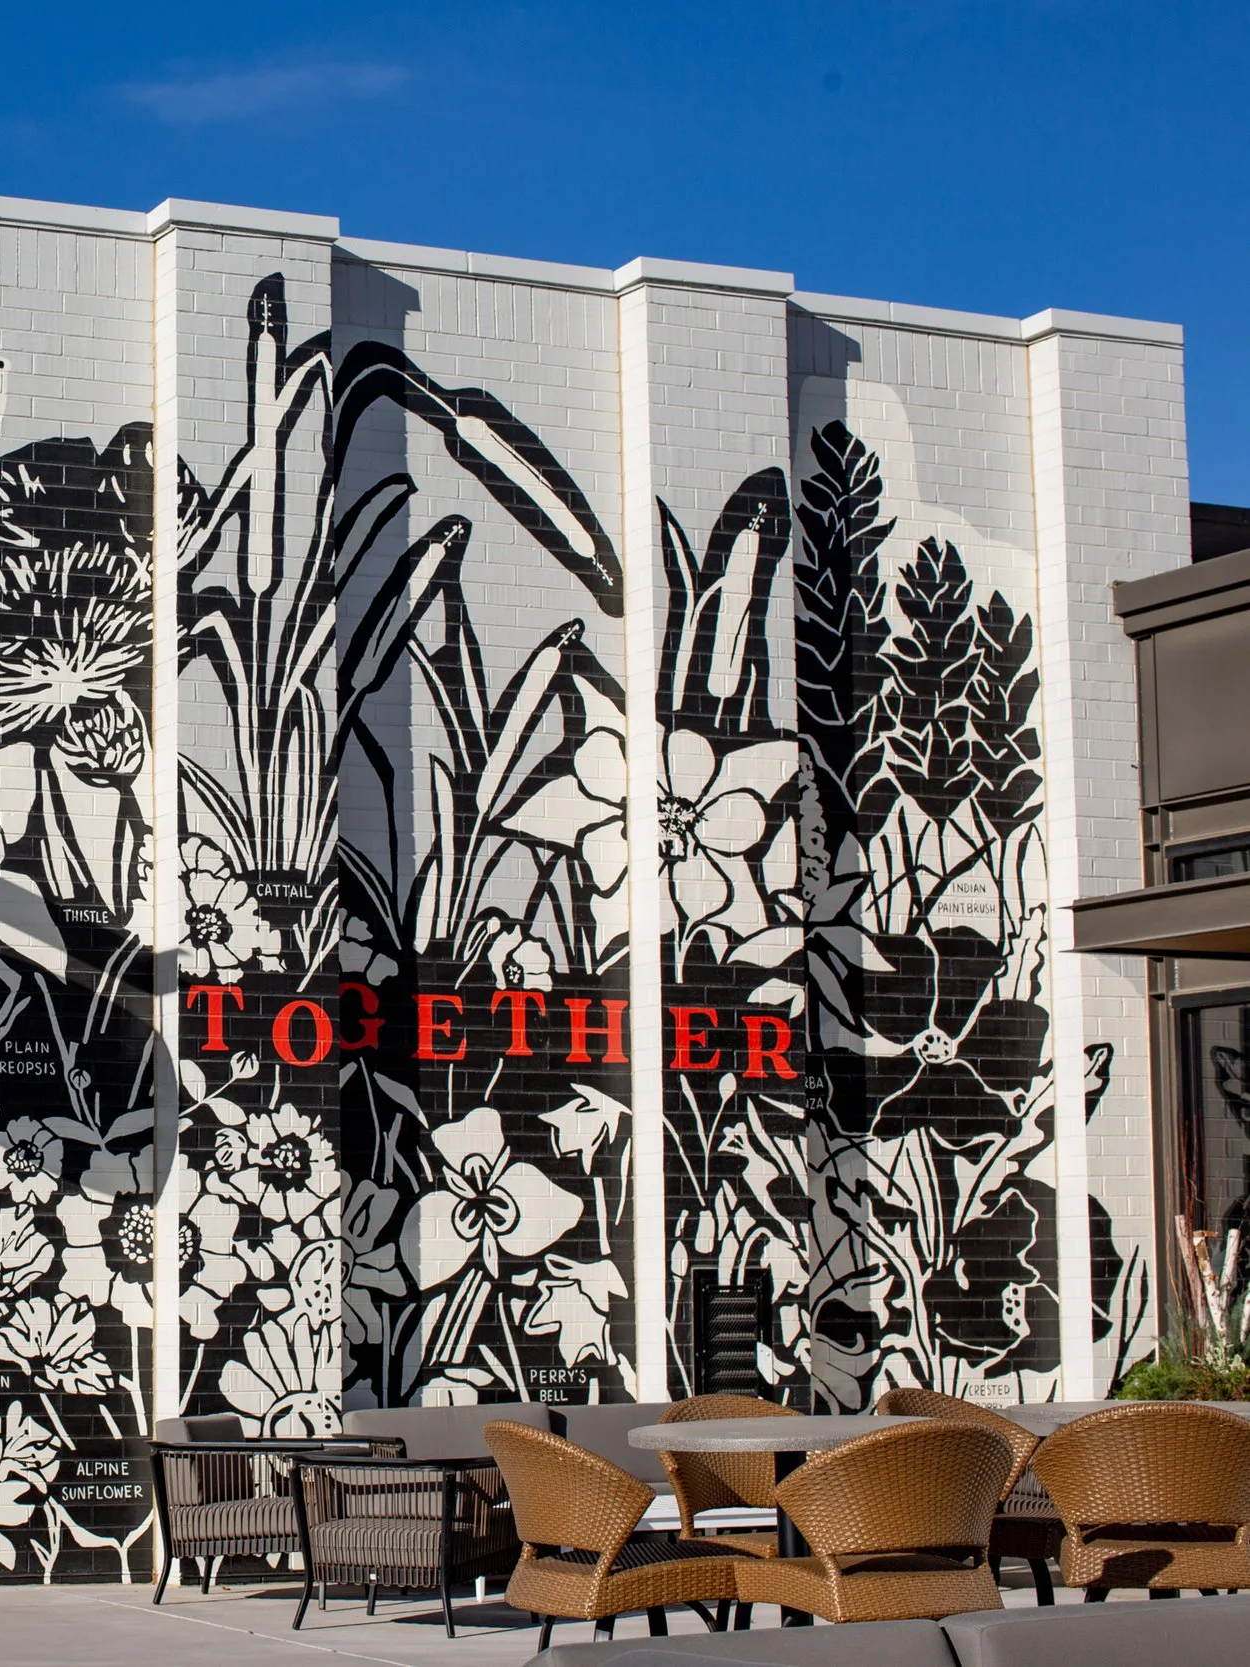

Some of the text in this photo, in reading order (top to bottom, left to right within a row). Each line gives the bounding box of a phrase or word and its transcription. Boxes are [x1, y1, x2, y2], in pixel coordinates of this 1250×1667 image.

[256, 883, 313, 898] CATTAIL
[952, 883, 986, 894] INDIAN
[937, 902, 996, 914] PAINTBRUSH
[63, 909, 109, 923] THISTLE
[187, 982, 798, 1079] TOGETHER
[5, 1040, 50, 1054] PLAIN
[530, 1369, 587, 1384] PERRY'S
[540, 1389, 569, 1402] BELL
[968, 1384, 1011, 1397] CRESTED
[76, 1461, 130, 1476] ALPINE
[62, 1485, 144, 1501] SUNFLOWER
